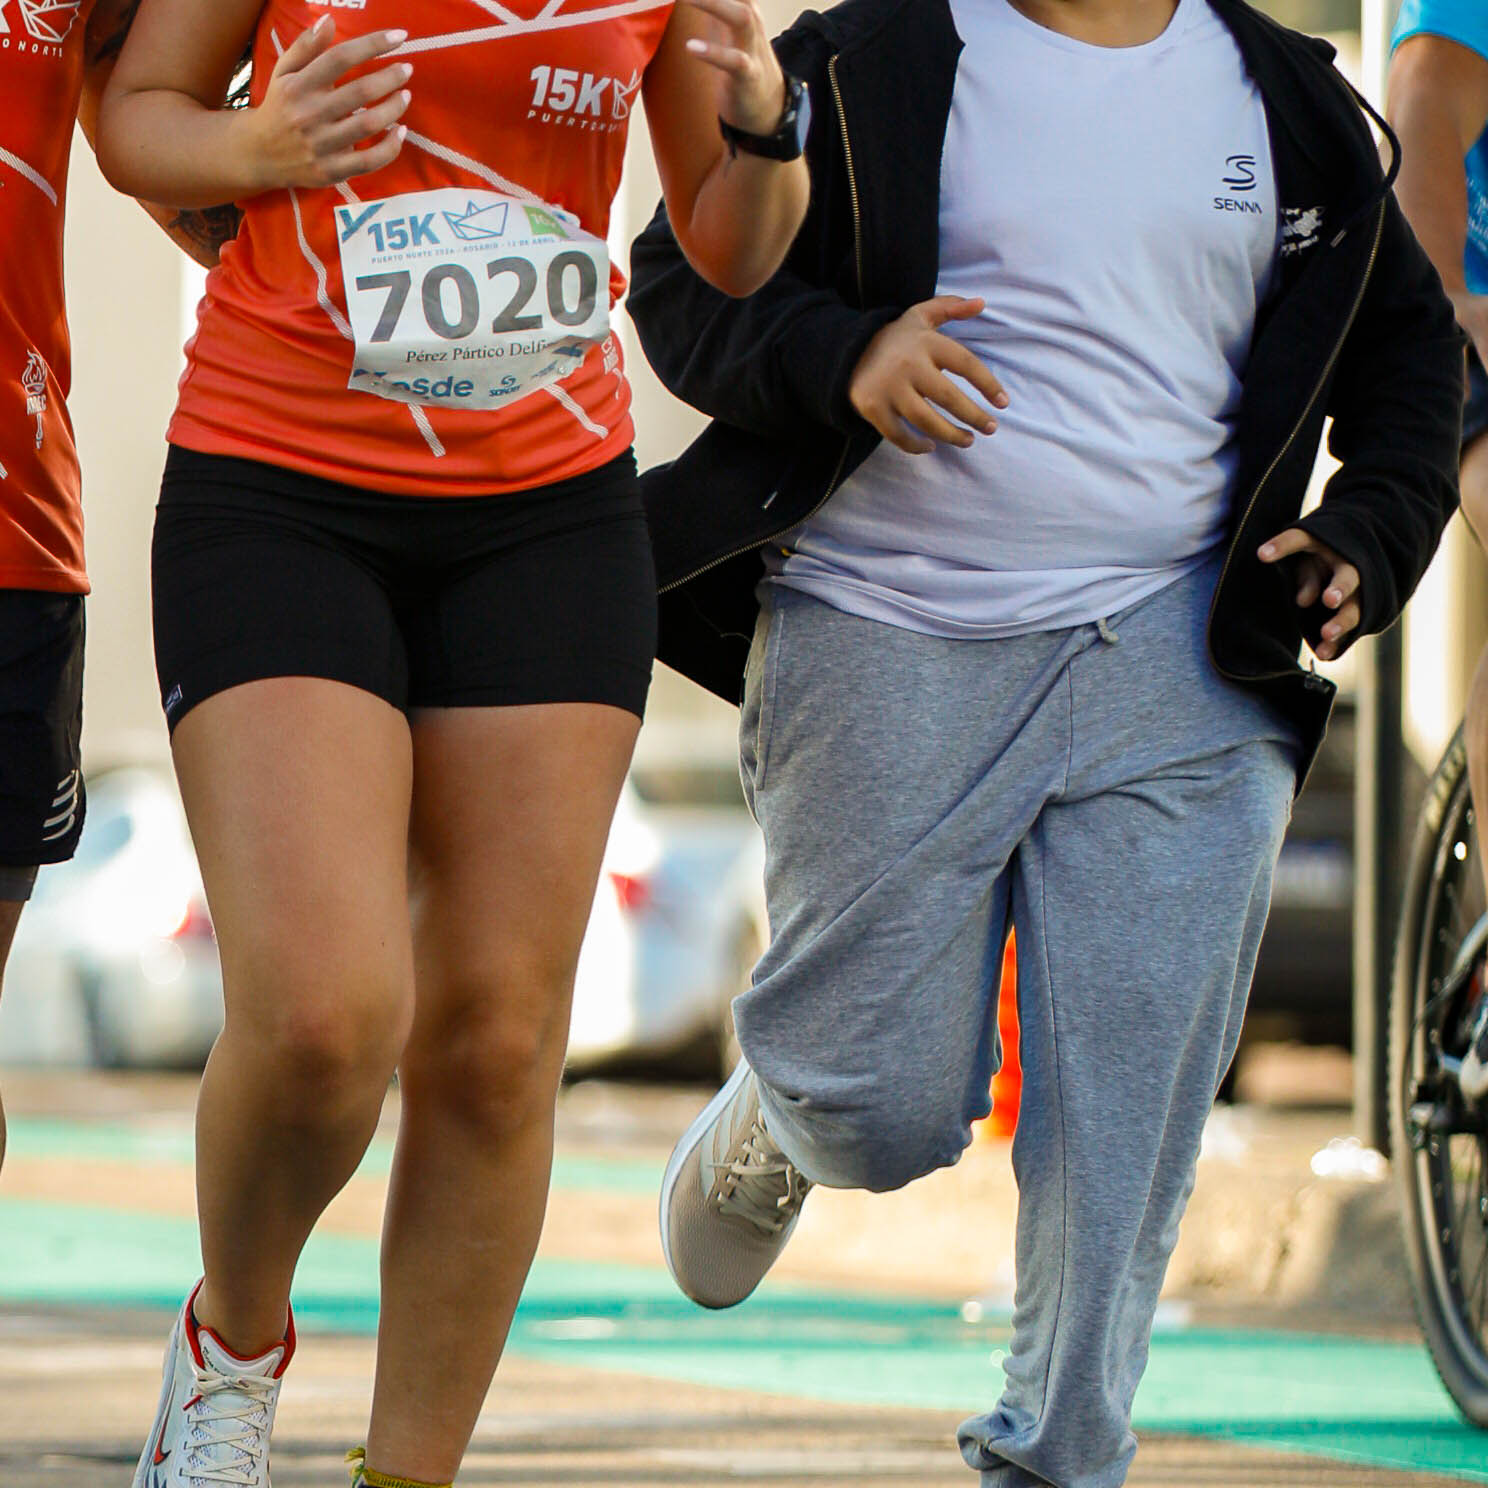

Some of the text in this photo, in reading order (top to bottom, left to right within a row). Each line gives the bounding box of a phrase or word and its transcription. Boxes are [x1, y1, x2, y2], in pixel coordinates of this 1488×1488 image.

[530, 65, 611, 116] 15K
[1213, 197, 1262, 214] SENNA
[367, 212, 441, 252] 15K
[355, 250, 598, 343] 7020
[406, 350, 448, 363] Pérez
[452, 344, 504, 361] Pártico
